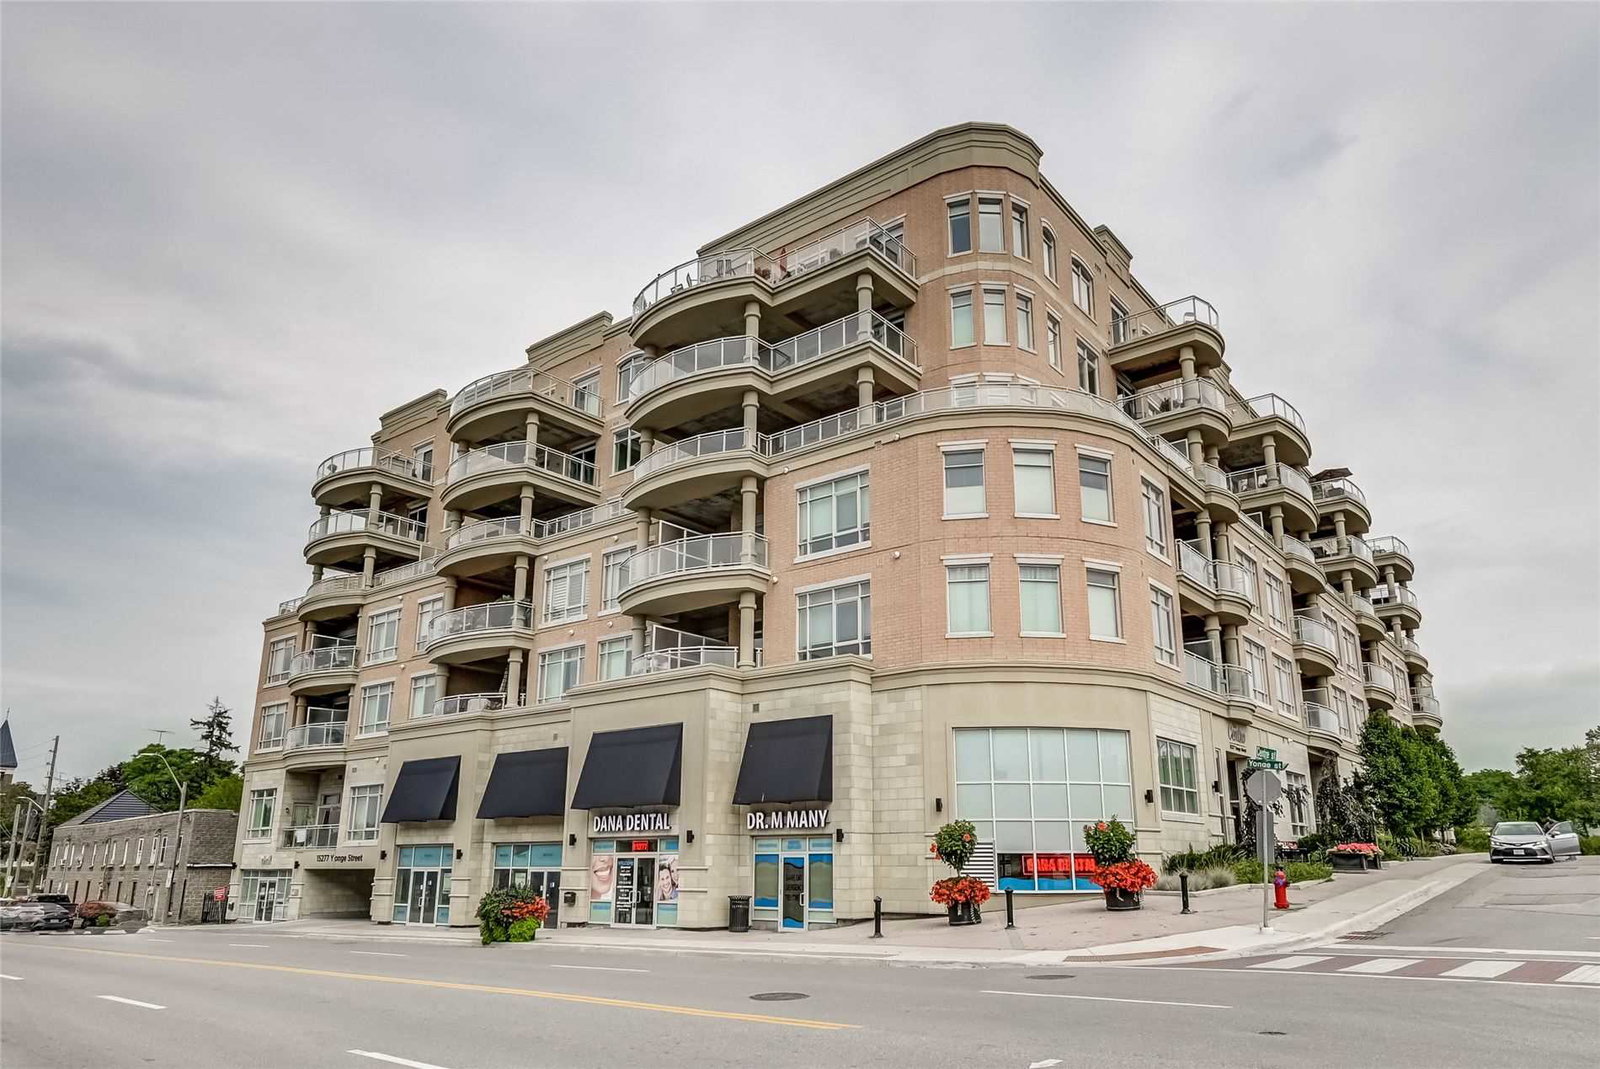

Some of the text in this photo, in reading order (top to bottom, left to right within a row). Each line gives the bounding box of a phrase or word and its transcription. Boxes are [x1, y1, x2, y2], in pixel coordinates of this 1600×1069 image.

[593, 813, 670, 832] DANA DENTAL
[747, 809, 828, 829] DR. M MANY
[347, 854, 363, 862] Street
